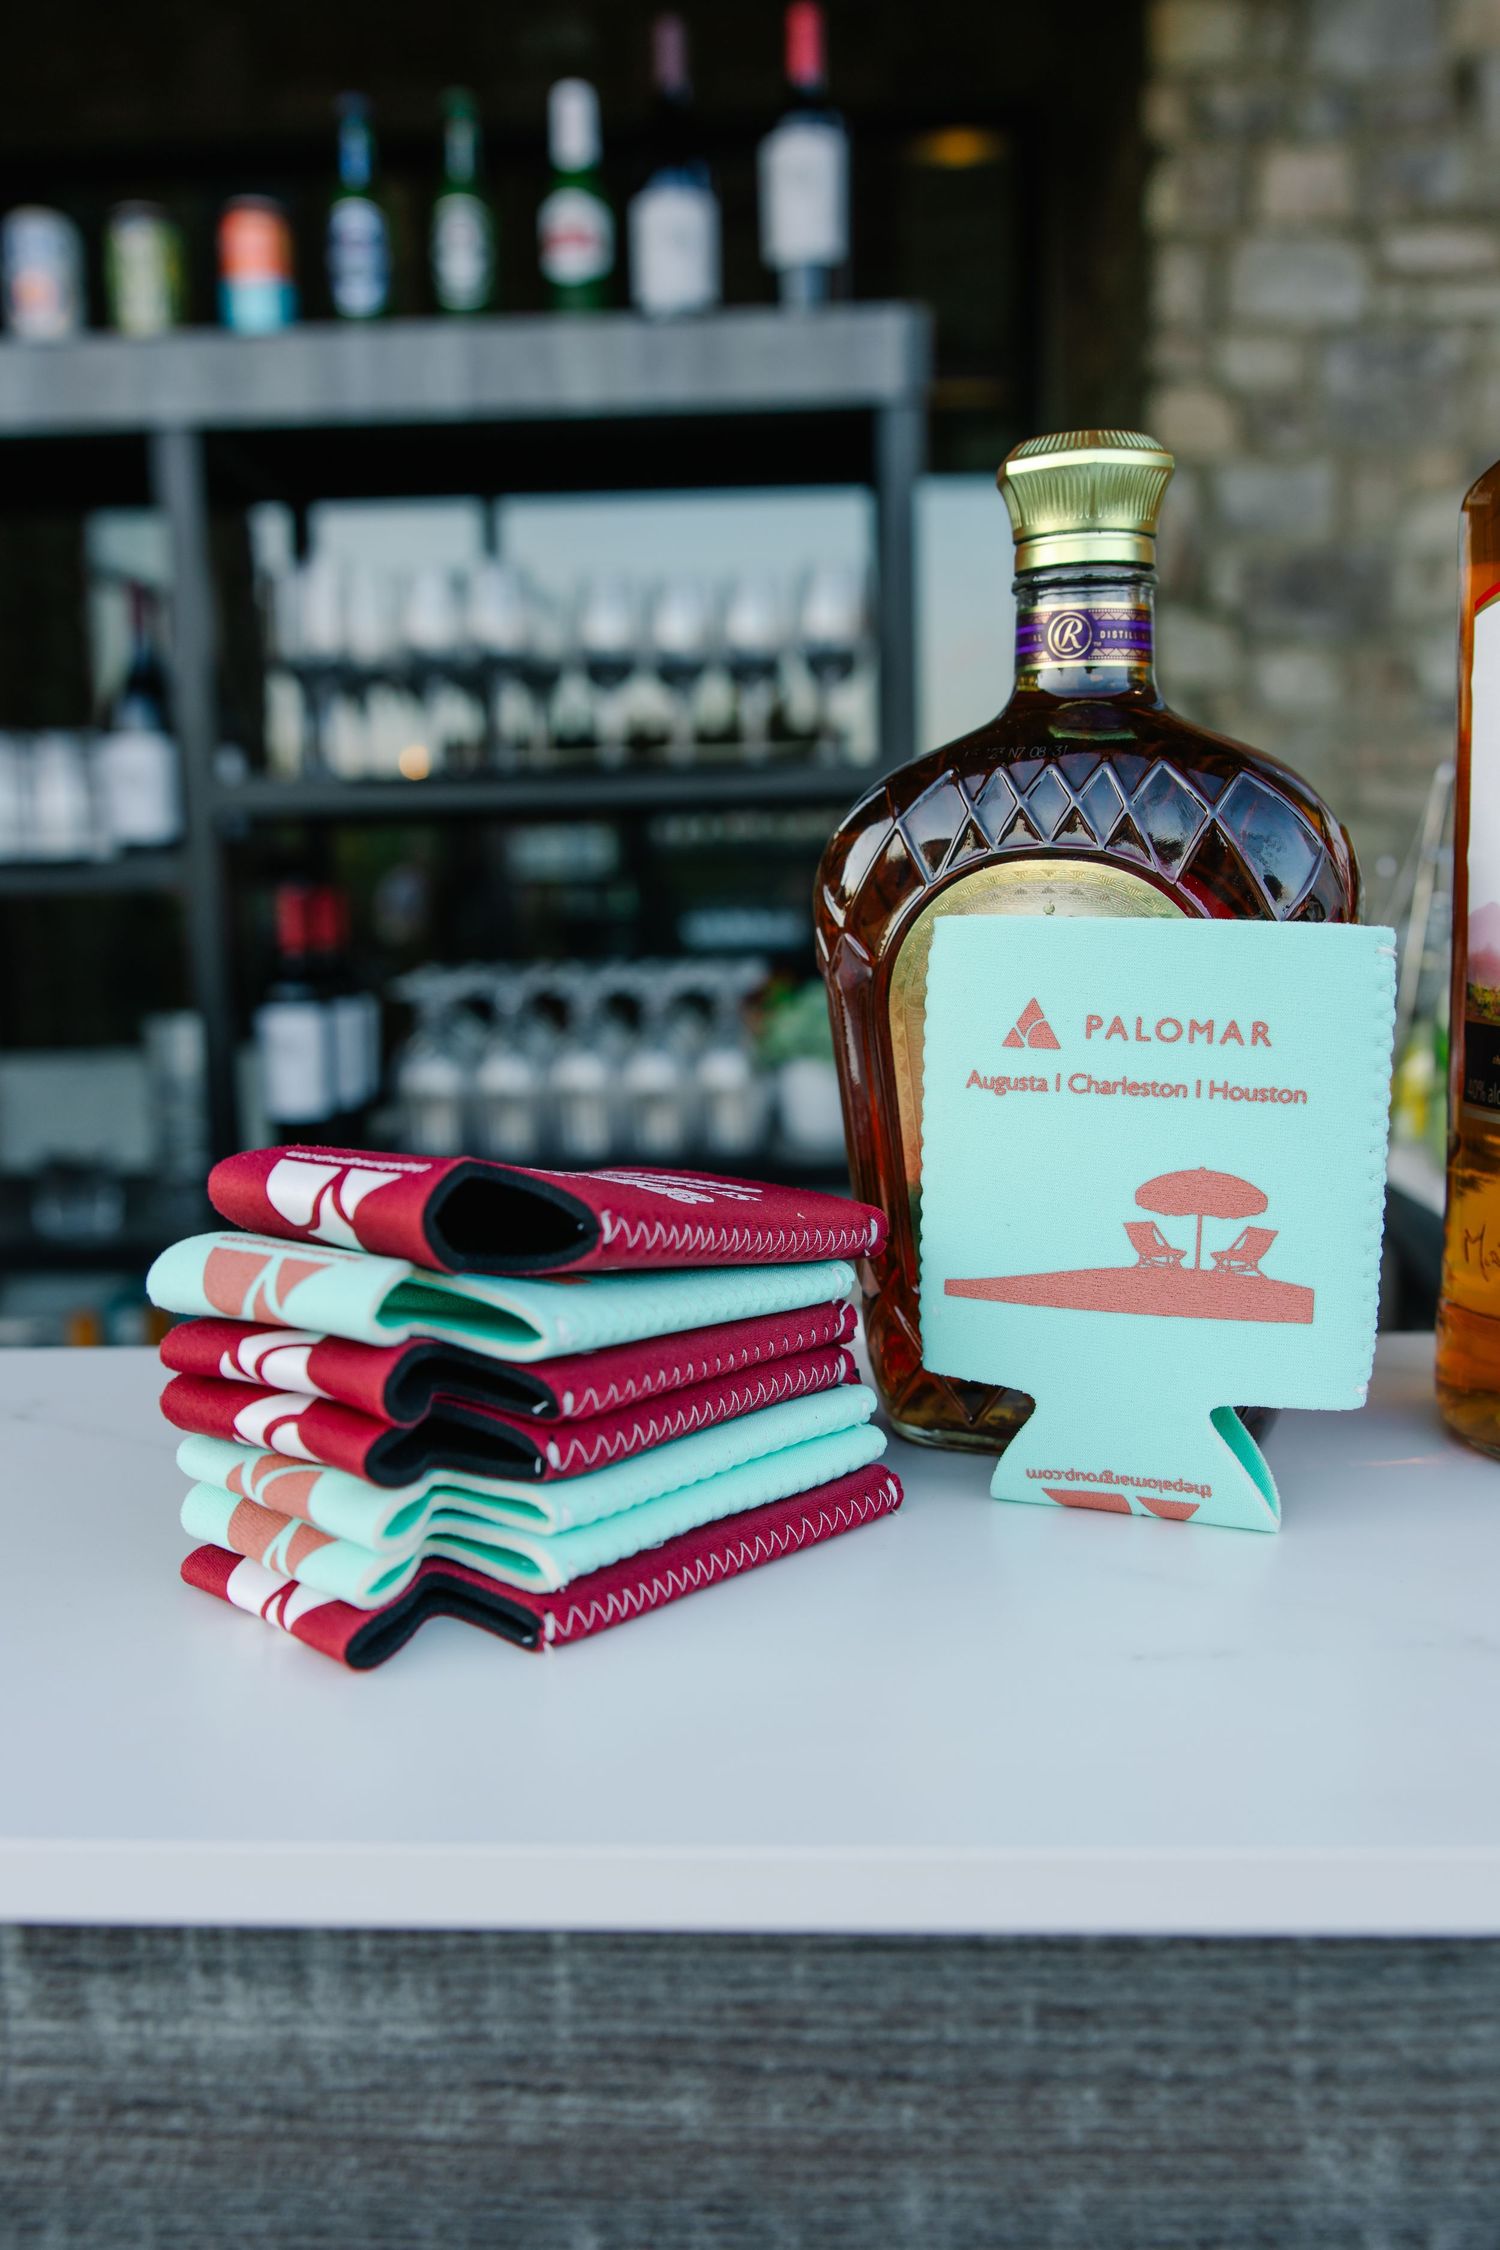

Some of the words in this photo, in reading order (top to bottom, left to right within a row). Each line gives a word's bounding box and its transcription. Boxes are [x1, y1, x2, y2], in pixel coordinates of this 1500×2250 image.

[1085, 1015, 1273, 1048] PALOMAR
[966, 1070, 1050, 1097] Augusta
[1068, 1074, 1190, 1100] Charleston
[1209, 1081, 1309, 1105] Houston
[1025, 1468, 1213, 1498] thepalomargroup.com
